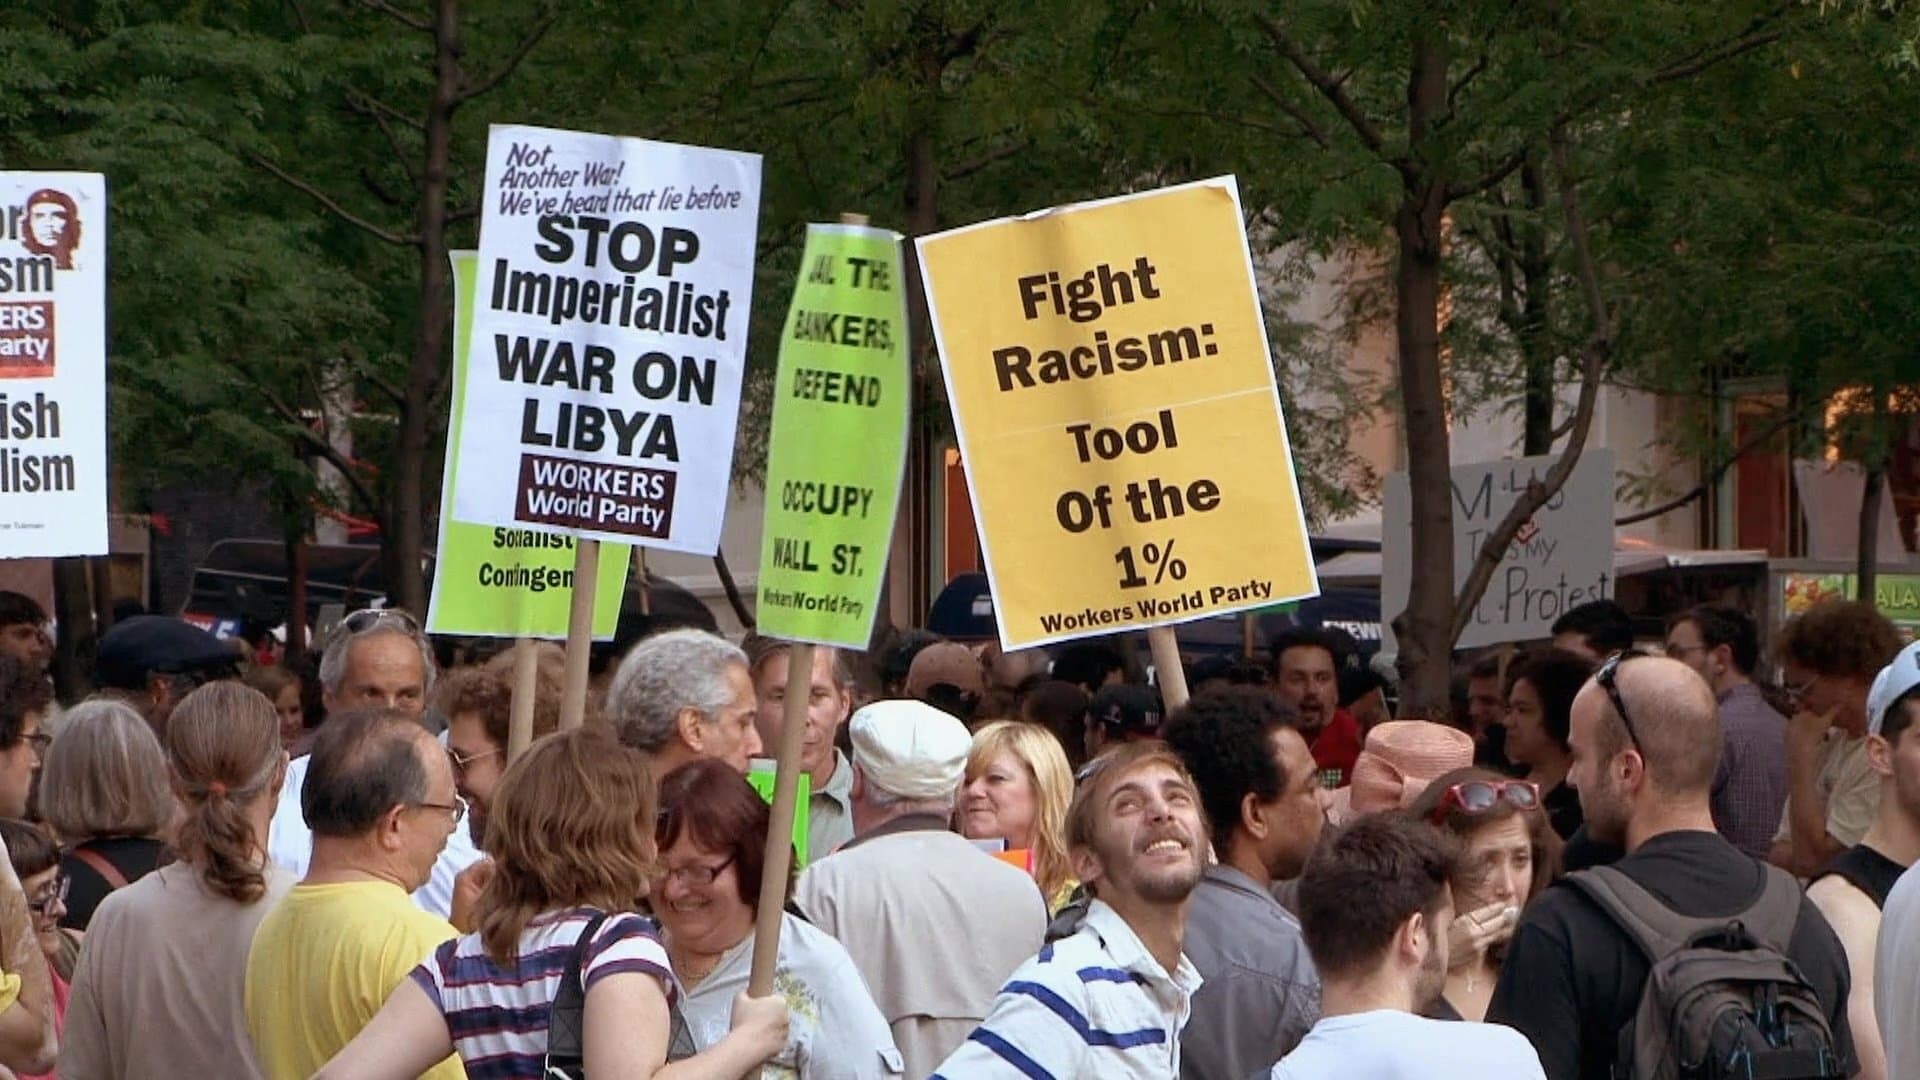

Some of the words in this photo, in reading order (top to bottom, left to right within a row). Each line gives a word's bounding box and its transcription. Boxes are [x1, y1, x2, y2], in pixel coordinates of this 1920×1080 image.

[499, 164, 579, 190] Another
[584, 160, 625, 187] War!
[506, 142, 553, 168] Not
[499, 190, 557, 216] We've
[560, 188, 612, 214] heard
[613, 187, 656, 213] that
[658, 186, 683, 210] lie
[685, 184, 742, 210] before
[534, 213, 700, 277] STOP
[847, 257, 891, 291] THE
[1018, 257, 1160, 323] Fight
[491, 258, 730, 341] Imperialist
[494, 334, 616, 394] WAR
[633, 351, 717, 406] ON
[992, 323, 1218, 392] Racism:
[793, 368, 882, 408] DEFEND
[520, 398, 680, 463] LIBYA
[1066, 409, 1178, 463] Tool
[533, 460, 665, 500] WORKERS
[782, 480, 874, 518] OCCUPY
[527, 488, 594, 518] World
[598, 497, 665, 532] Party
[1056, 485, 1113, 533] Of
[1125, 478, 1221, 524] the
[772, 537, 819, 572] WALL
[832, 544, 863, 577] ST.
[1114, 538, 1187, 590] 1%
[793, 591, 840, 612] World
[1040, 603, 1134, 633] Workers
[1137, 591, 1201, 619] World
[1209, 580, 1273, 606] Party
